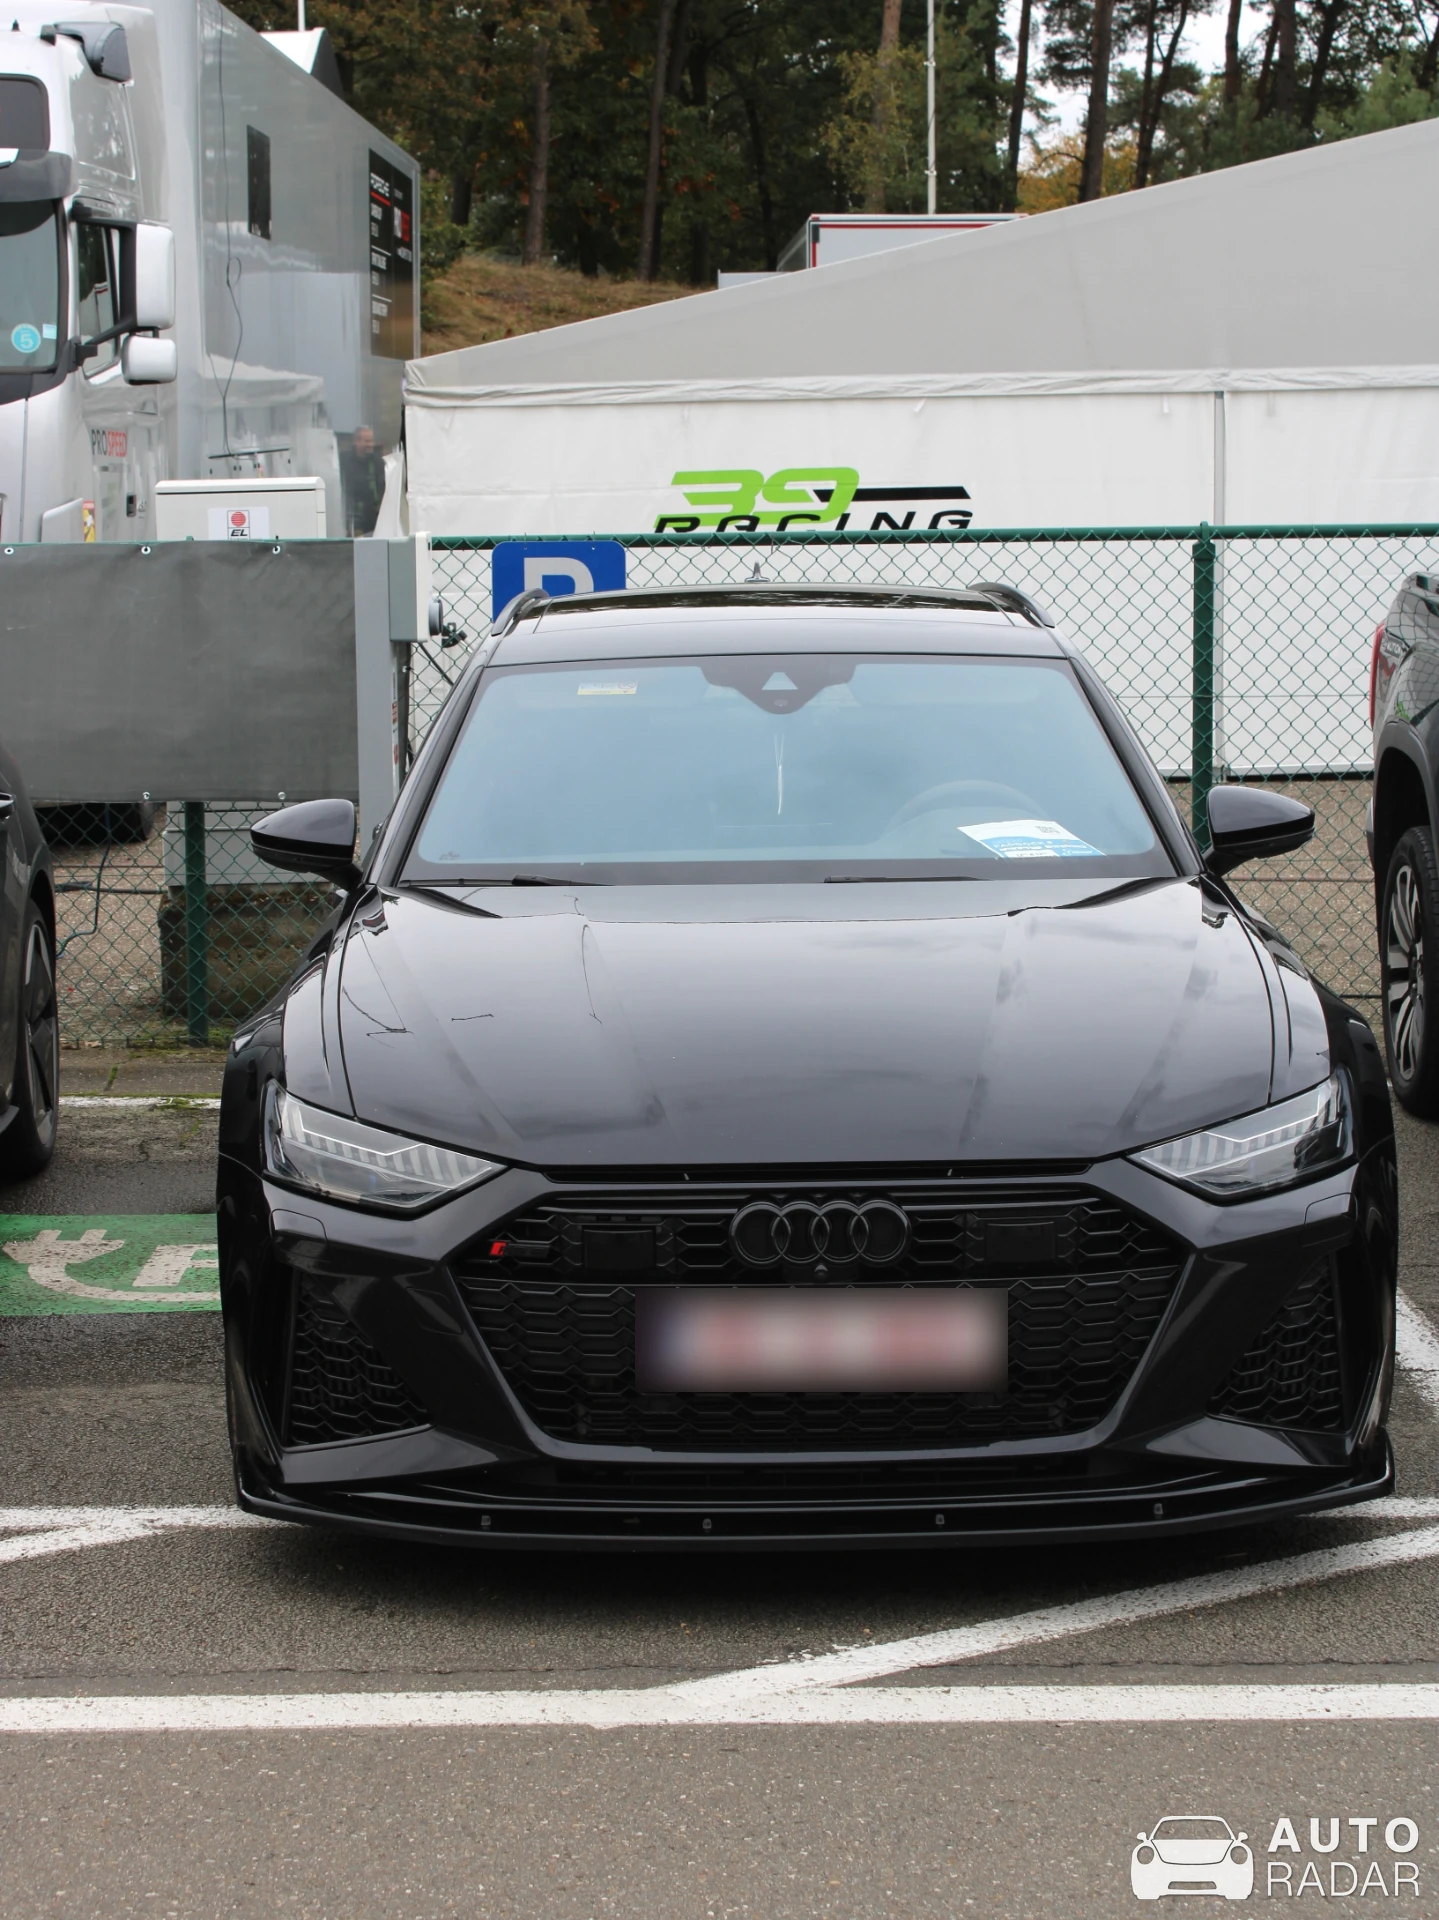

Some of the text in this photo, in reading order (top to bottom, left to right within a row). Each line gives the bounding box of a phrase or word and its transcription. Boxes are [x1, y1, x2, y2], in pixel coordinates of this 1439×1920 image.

[20, 329, 33, 349] 5
[91, 428, 127, 457] PROSPEED
[653, 467, 859, 528] 39
[230, 529, 248, 537] EL
[654, 510, 973, 534] RACING
